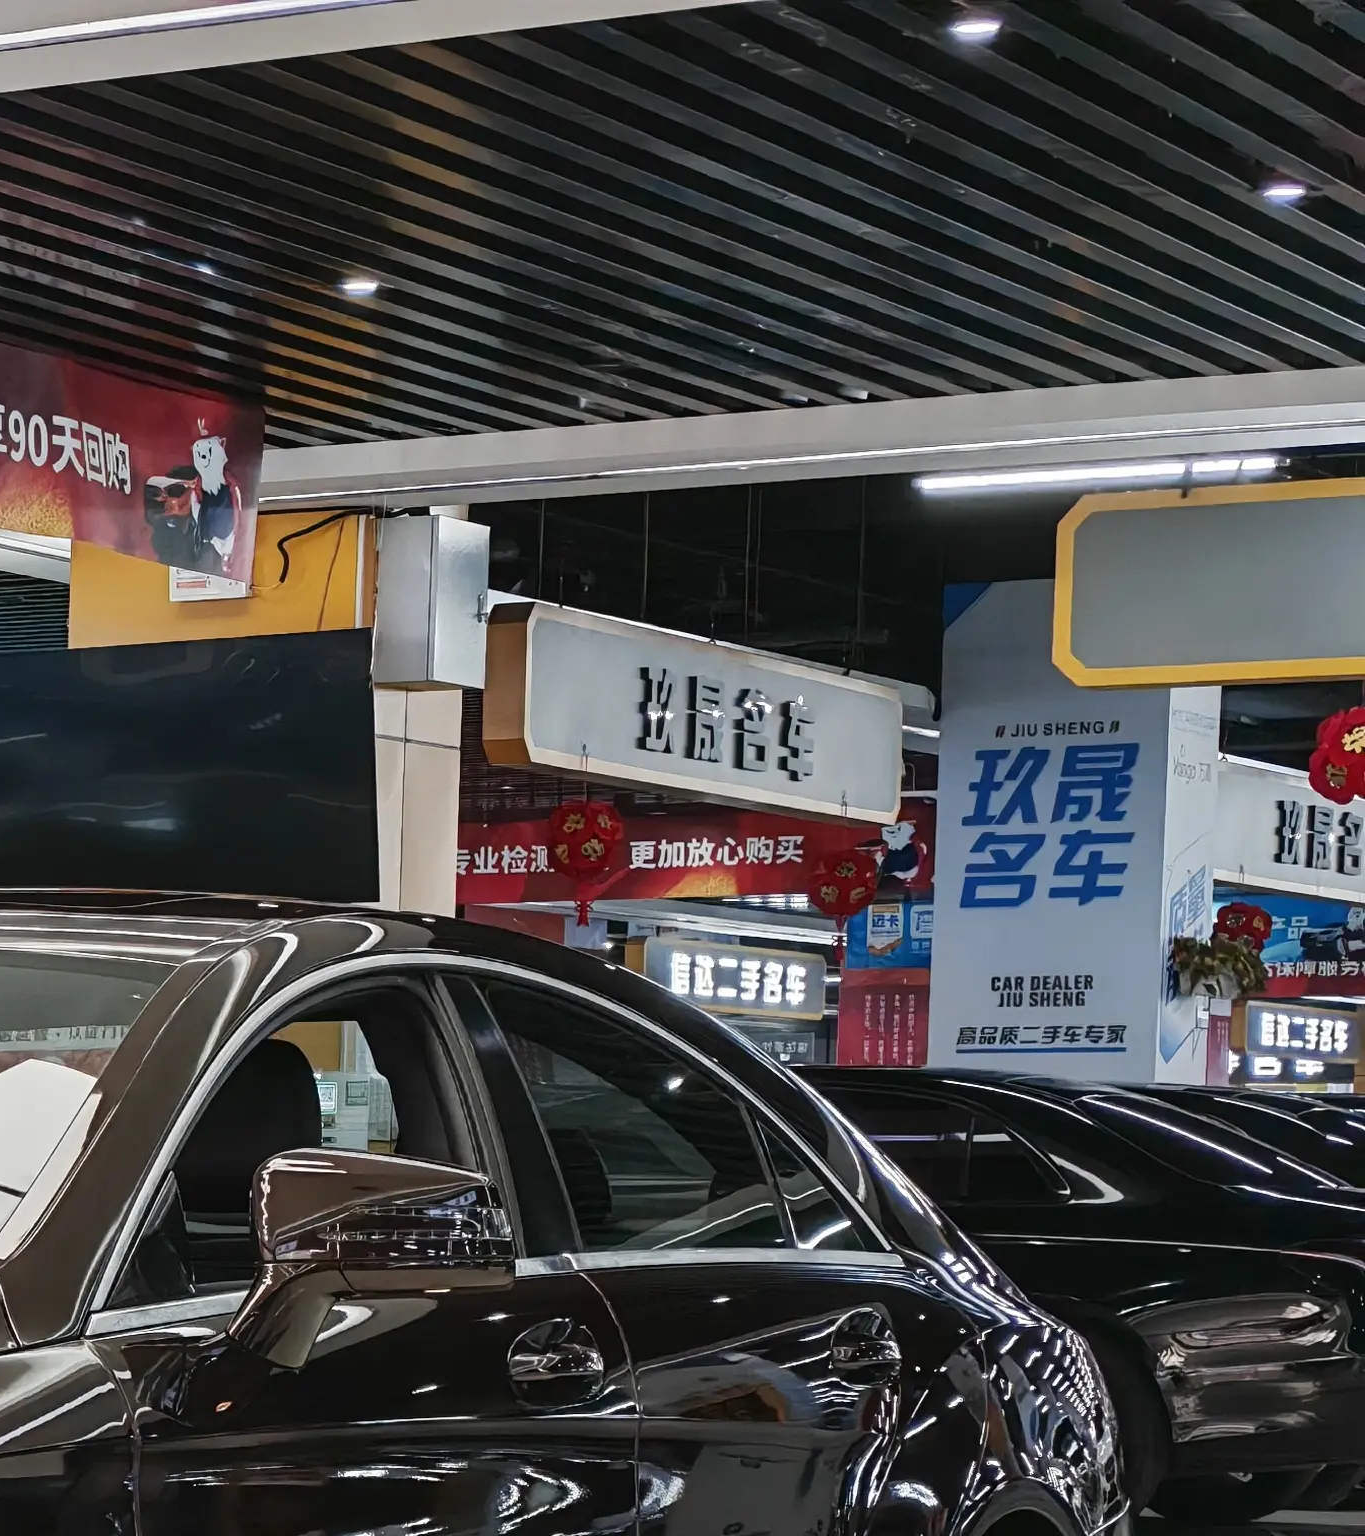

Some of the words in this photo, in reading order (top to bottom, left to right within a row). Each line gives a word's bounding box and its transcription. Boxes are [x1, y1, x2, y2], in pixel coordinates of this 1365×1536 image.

[636, 666, 816, 782] 玖晟名车
[1010, 723, 1040, 738] JIU
[1043, 720, 1106, 737] SHENG
[961, 743, 1140, 826] 玖晟
[629, 835, 805, 870] 更加放心购买
[960, 829, 1136, 909] 名车
[670, 951, 807, 1006] 信达二手名车
[991, 976, 1025, 992] CAR
[1029, 974, 1094, 991] DEALER
[997, 992, 1024, 1008] JIU
[1028, 991, 1086, 1007] SHENG
[956, 1025, 1127, 1046] 高品质二手车专家
